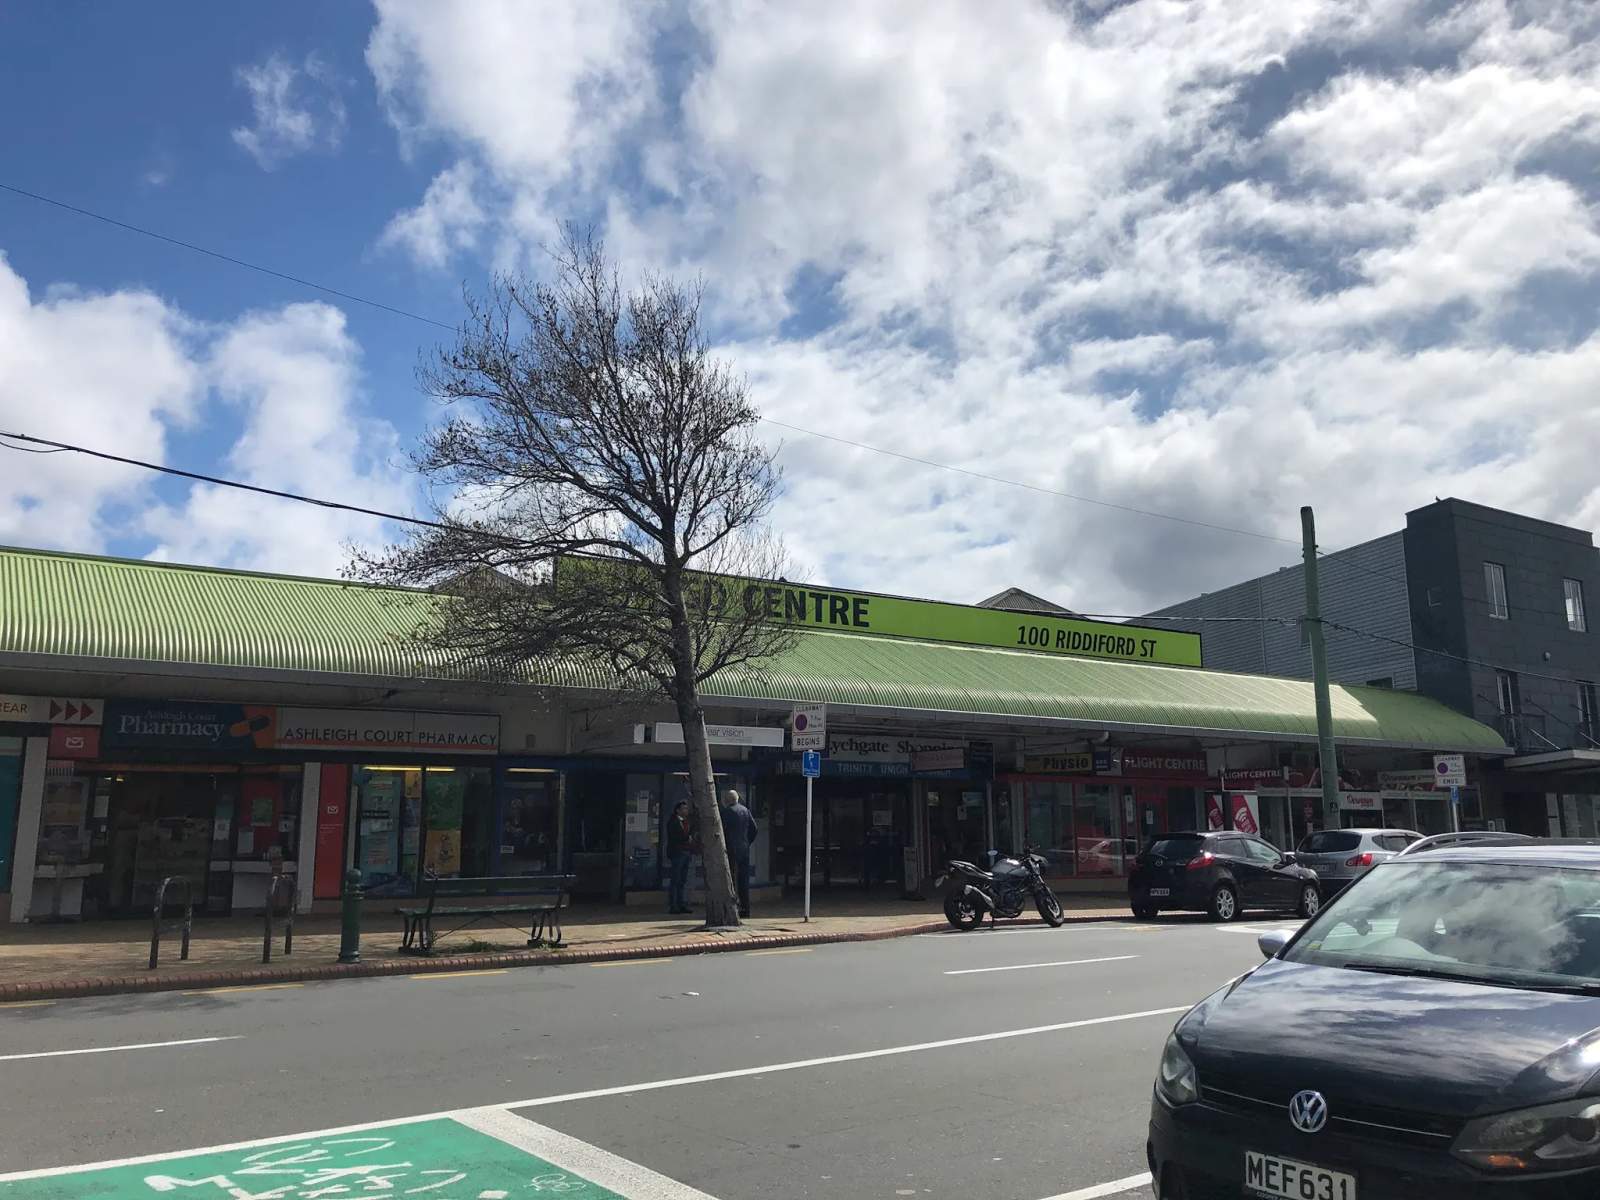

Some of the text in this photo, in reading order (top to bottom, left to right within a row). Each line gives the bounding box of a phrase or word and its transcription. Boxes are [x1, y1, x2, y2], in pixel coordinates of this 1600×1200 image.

[744, 585, 870, 627] CENTRE
[1017, 625, 1157, 658] 100 RIDDIFORD ST
[117, 714, 225, 742] Pharmacy
[284, 727, 497, 746] ASHLEIGH COURT PHARMACY
[721, 727, 745, 738] vision
[796, 737, 821, 747] BEGINS
[1124, 756, 1164, 769] FLIGHT
[1166, 757, 1206, 771] CENTRE
[1247, 1153, 1347, 1200] MEF631
